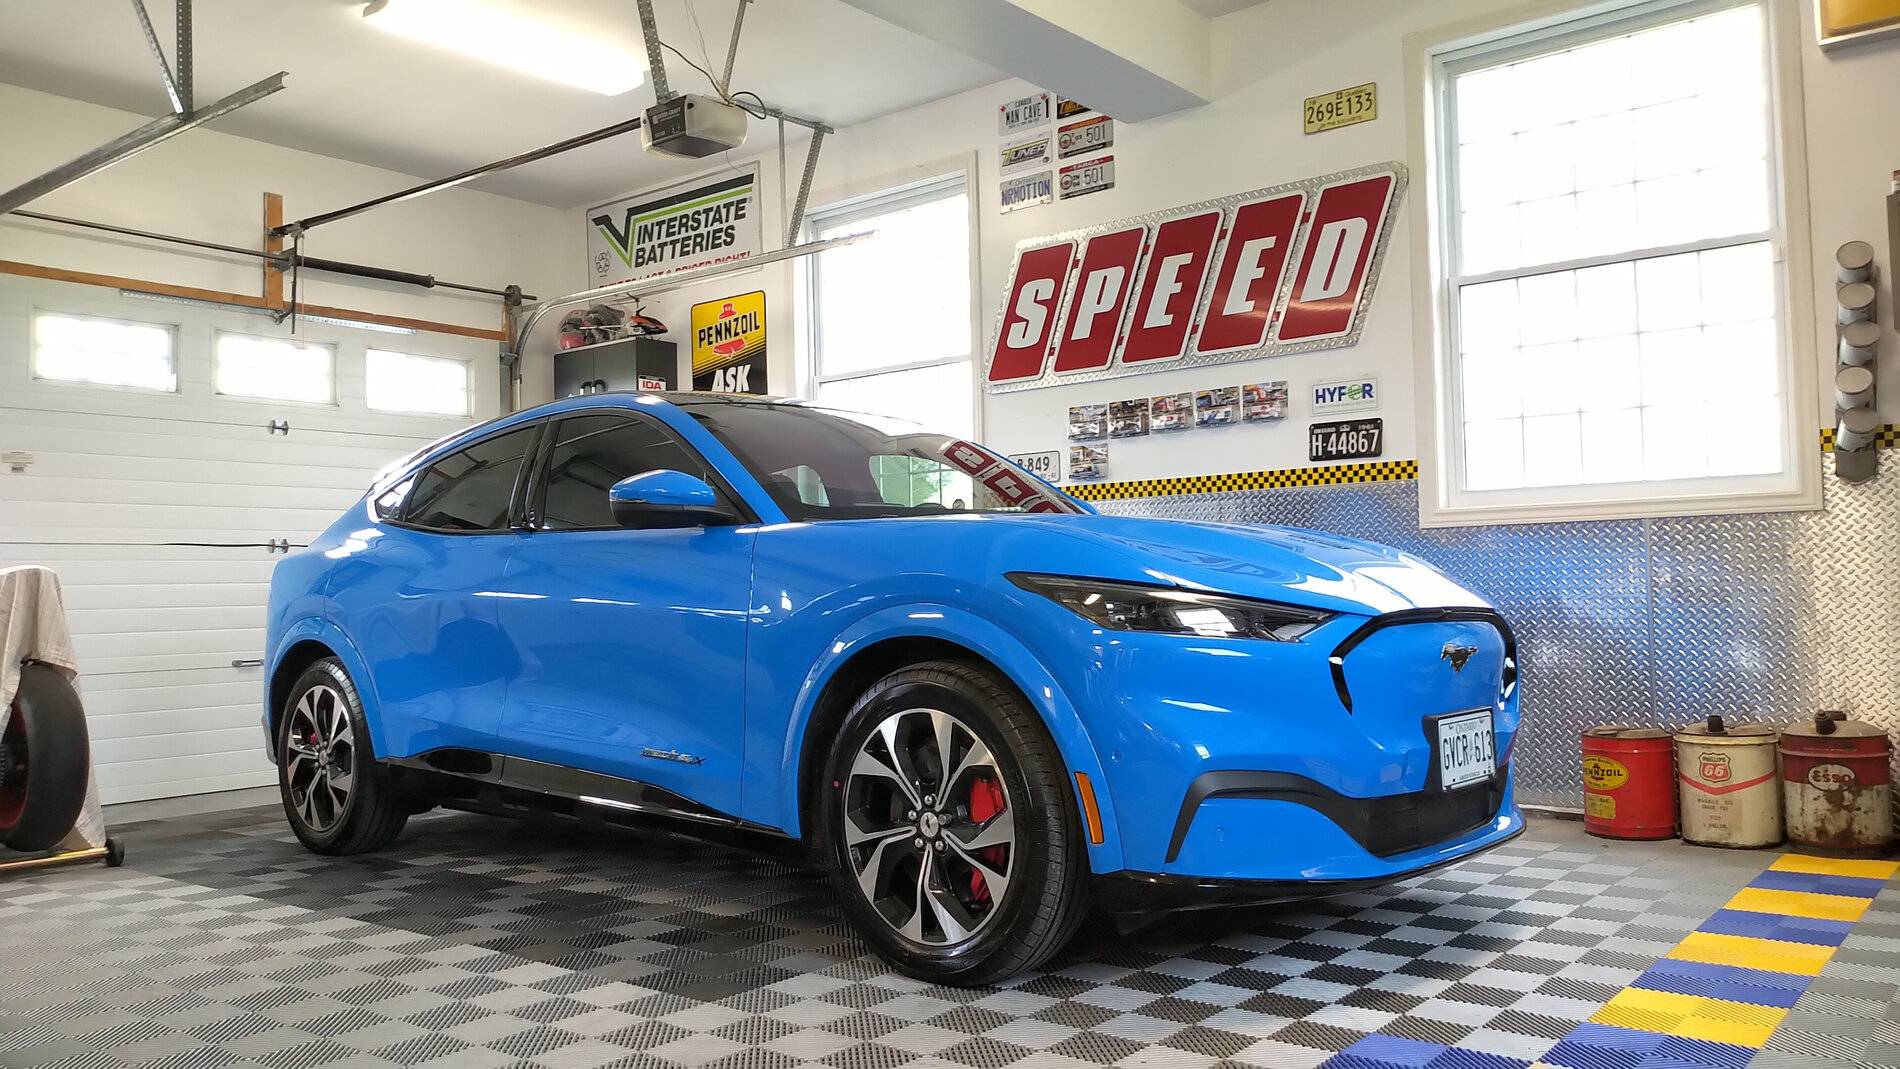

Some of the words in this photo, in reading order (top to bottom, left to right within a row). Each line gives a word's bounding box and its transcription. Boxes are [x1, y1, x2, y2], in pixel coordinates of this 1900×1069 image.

[1005, 109, 1020, 126] MAN
[1023, 102, 1042, 121] CAVE
[1045, 98, 1050, 119] 1
[1307, 92, 1373, 125] 269E133
[1086, 123, 1106, 144] 501
[1083, 166, 1104, 186] 501
[1001, 179, 1050, 207] NRMOTION
[636, 197, 747, 246] INTERSTATE
[634, 224, 736, 269] BATTERIES
[1006, 216, 1369, 349] SPEED
[698, 310, 760, 349] PENNZOIL
[642, 380, 661, 390] IDA
[711, 364, 751, 392] ASK
[1311, 428, 1380, 457] H-44867
[1443, 733, 1470, 771] GVCR
[1474, 729, 1494, 763] 613
[1584, 767, 1624, 777] ENNZOIL
[1704, 765, 1725, 777] 66
